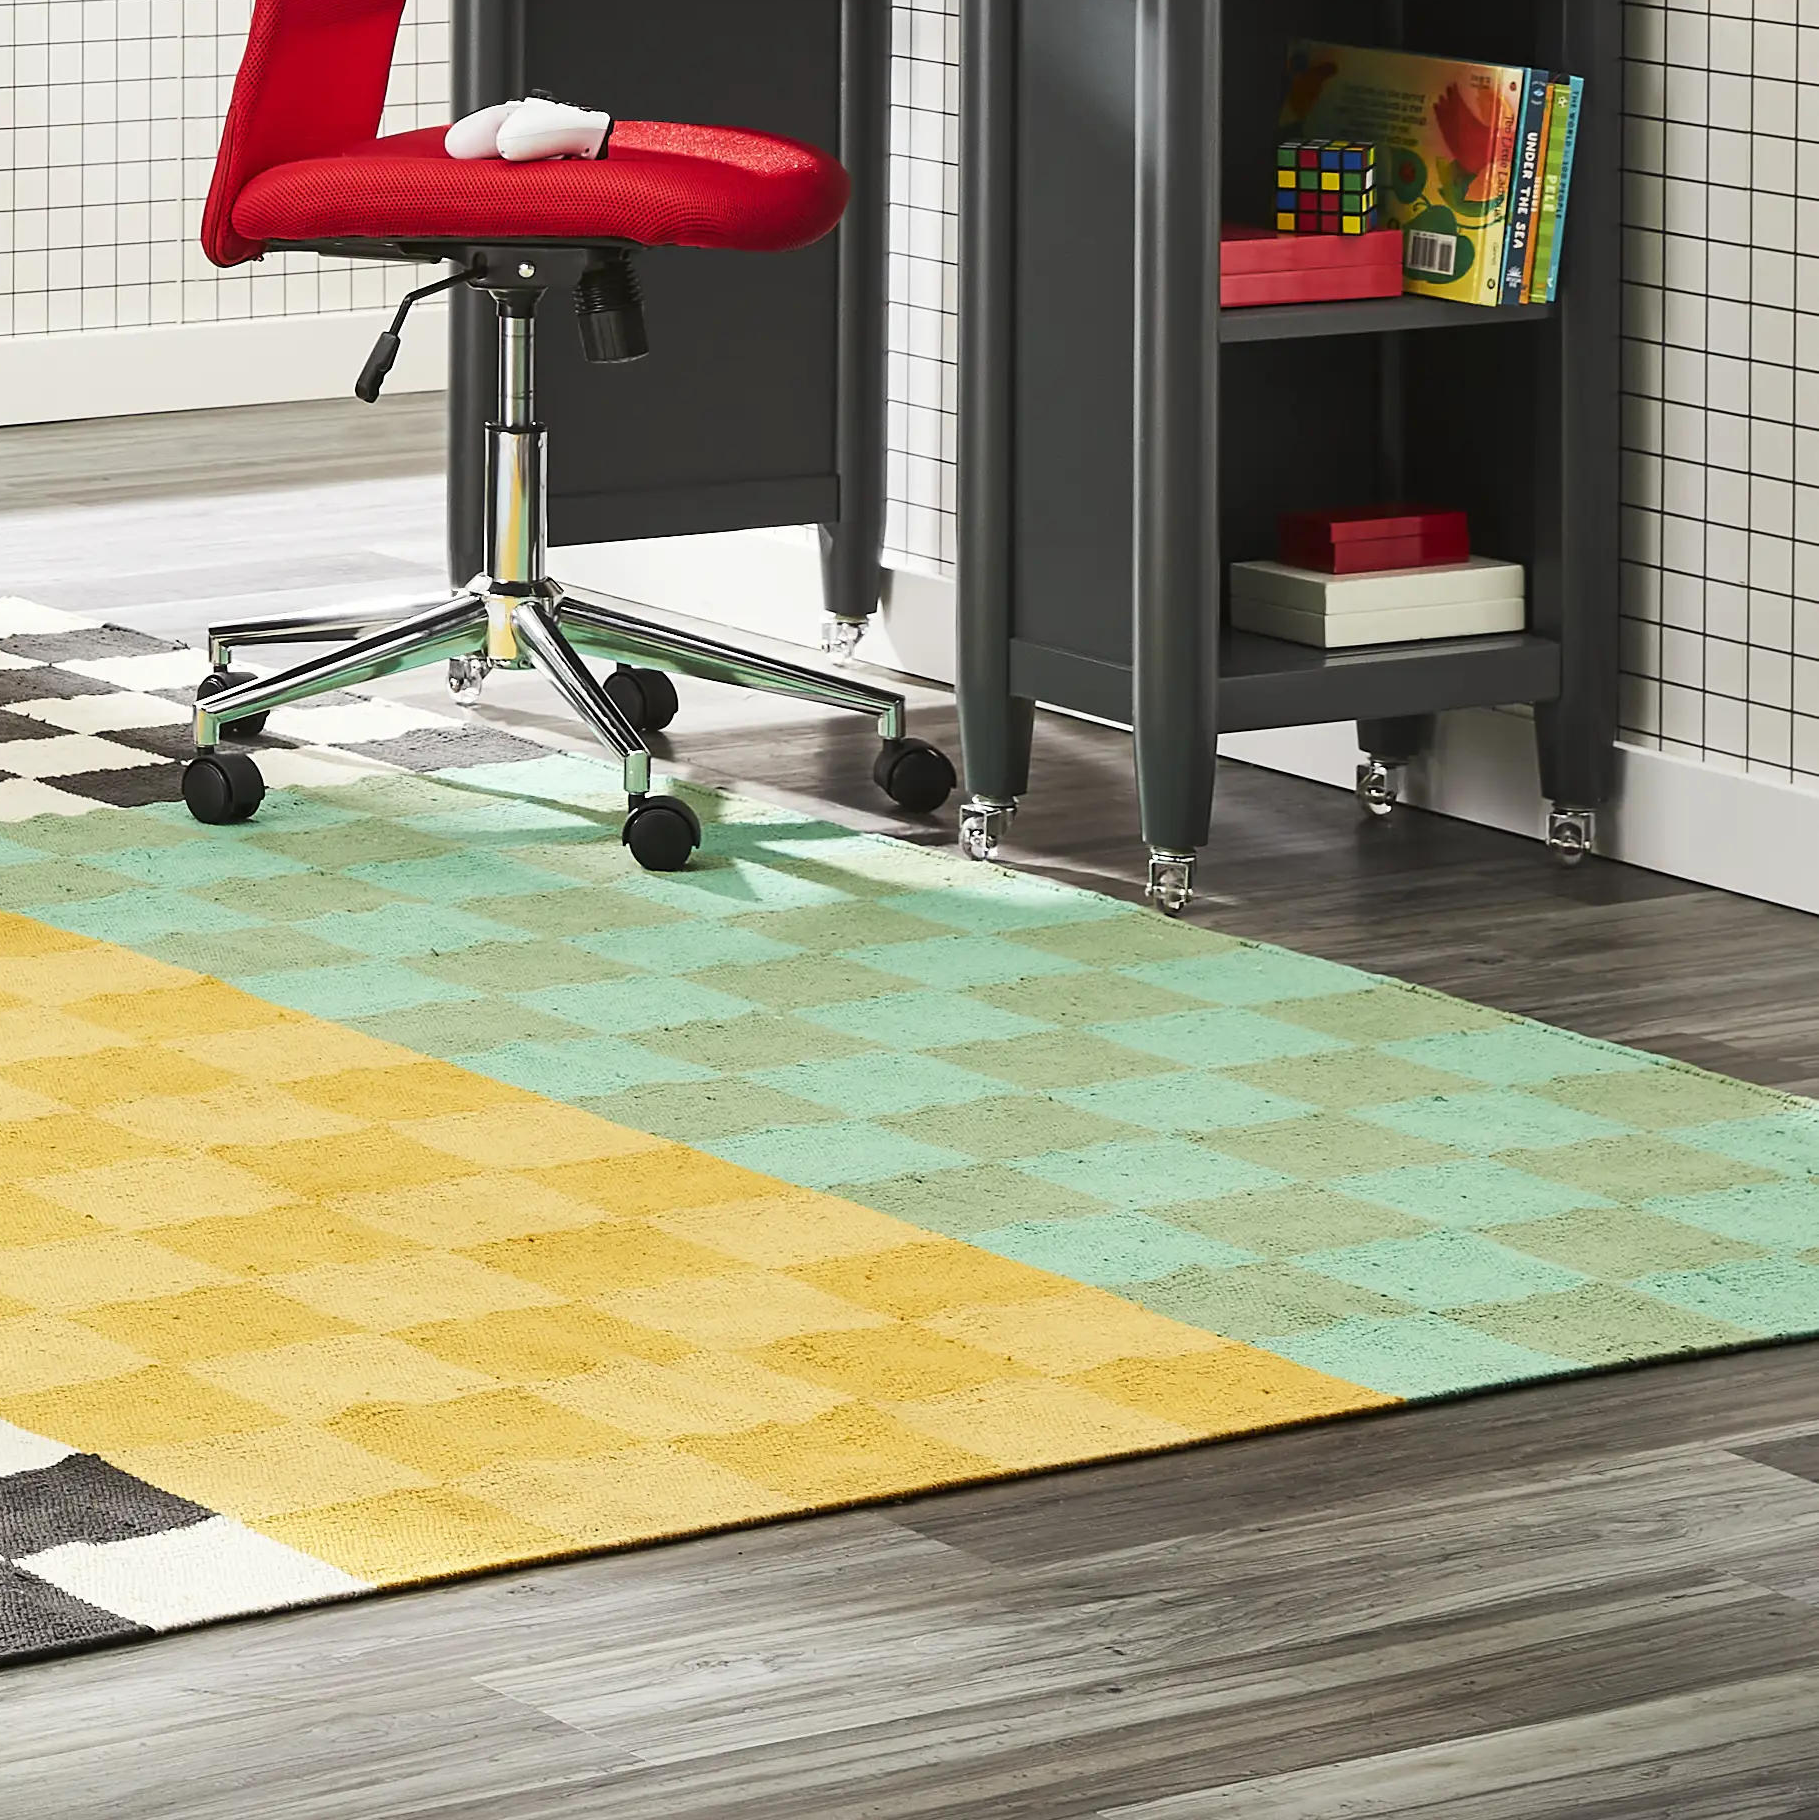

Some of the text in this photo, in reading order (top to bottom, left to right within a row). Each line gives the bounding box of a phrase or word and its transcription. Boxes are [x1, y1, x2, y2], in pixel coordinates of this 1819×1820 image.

[1523, 132, 1538, 179] UNDER
[1518, 186, 1531, 215] THE
[1513, 221, 1526, 249] SEA
